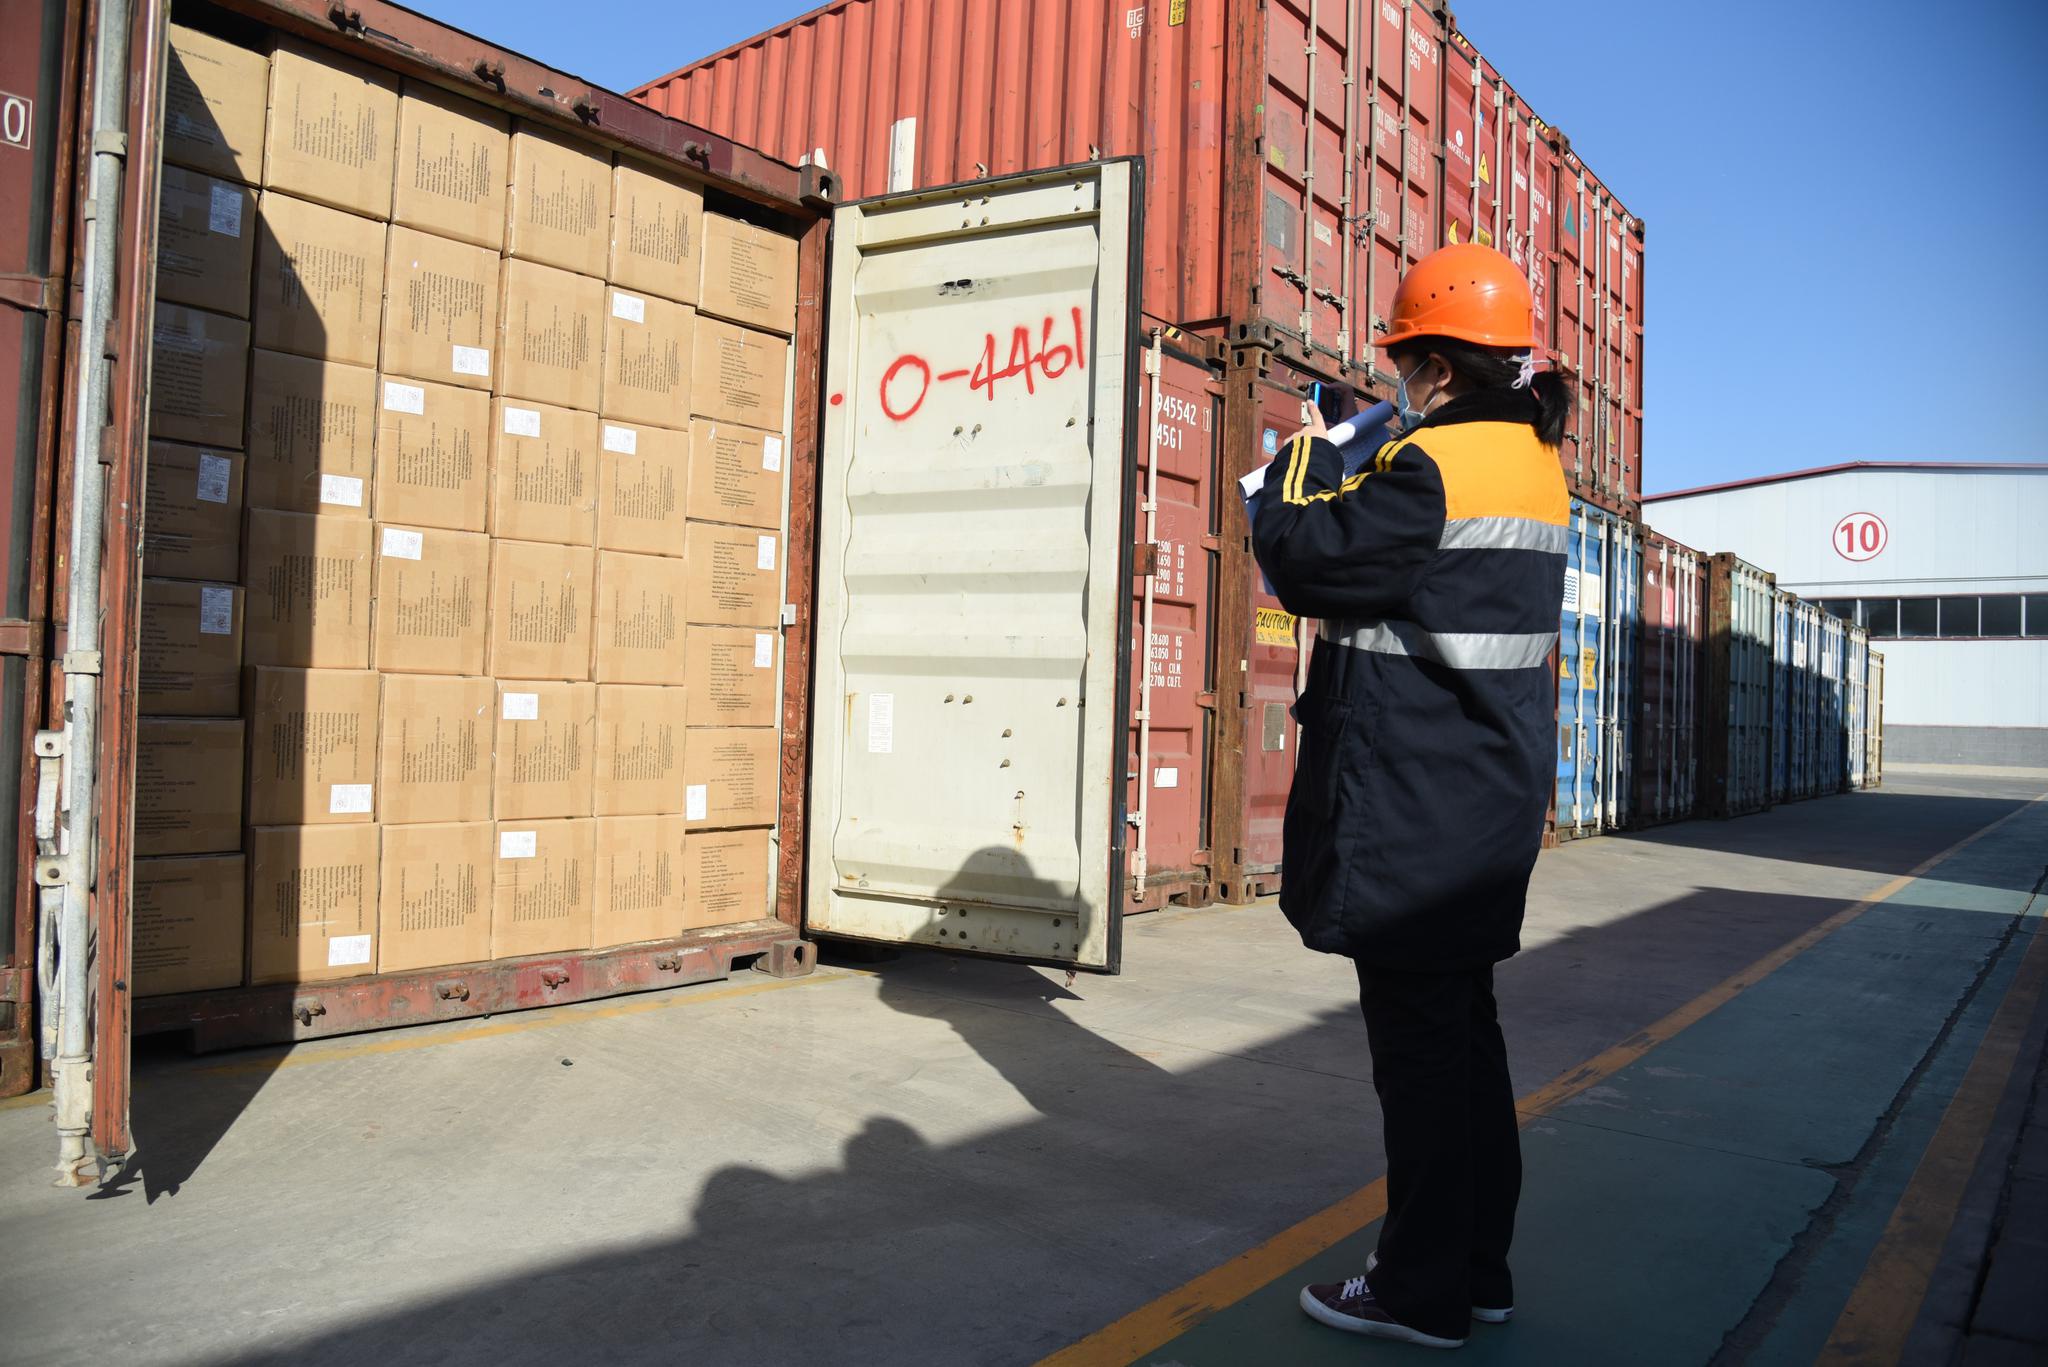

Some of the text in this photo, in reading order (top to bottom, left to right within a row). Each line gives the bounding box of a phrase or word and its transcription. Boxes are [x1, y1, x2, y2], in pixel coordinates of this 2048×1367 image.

[1130, 26, 1142, 39] 61
[1409, 27, 1429, 58] 44392
[1409, 48, 1420, 72] 5G1
[3, 97, 26, 143] 0
[1156, 392, 1197, 426] 945542
[1156, 423, 1182, 451] 45G1
[1841, 520, 1880, 553] 10
[1256, 611, 1293, 631] CAUTION
